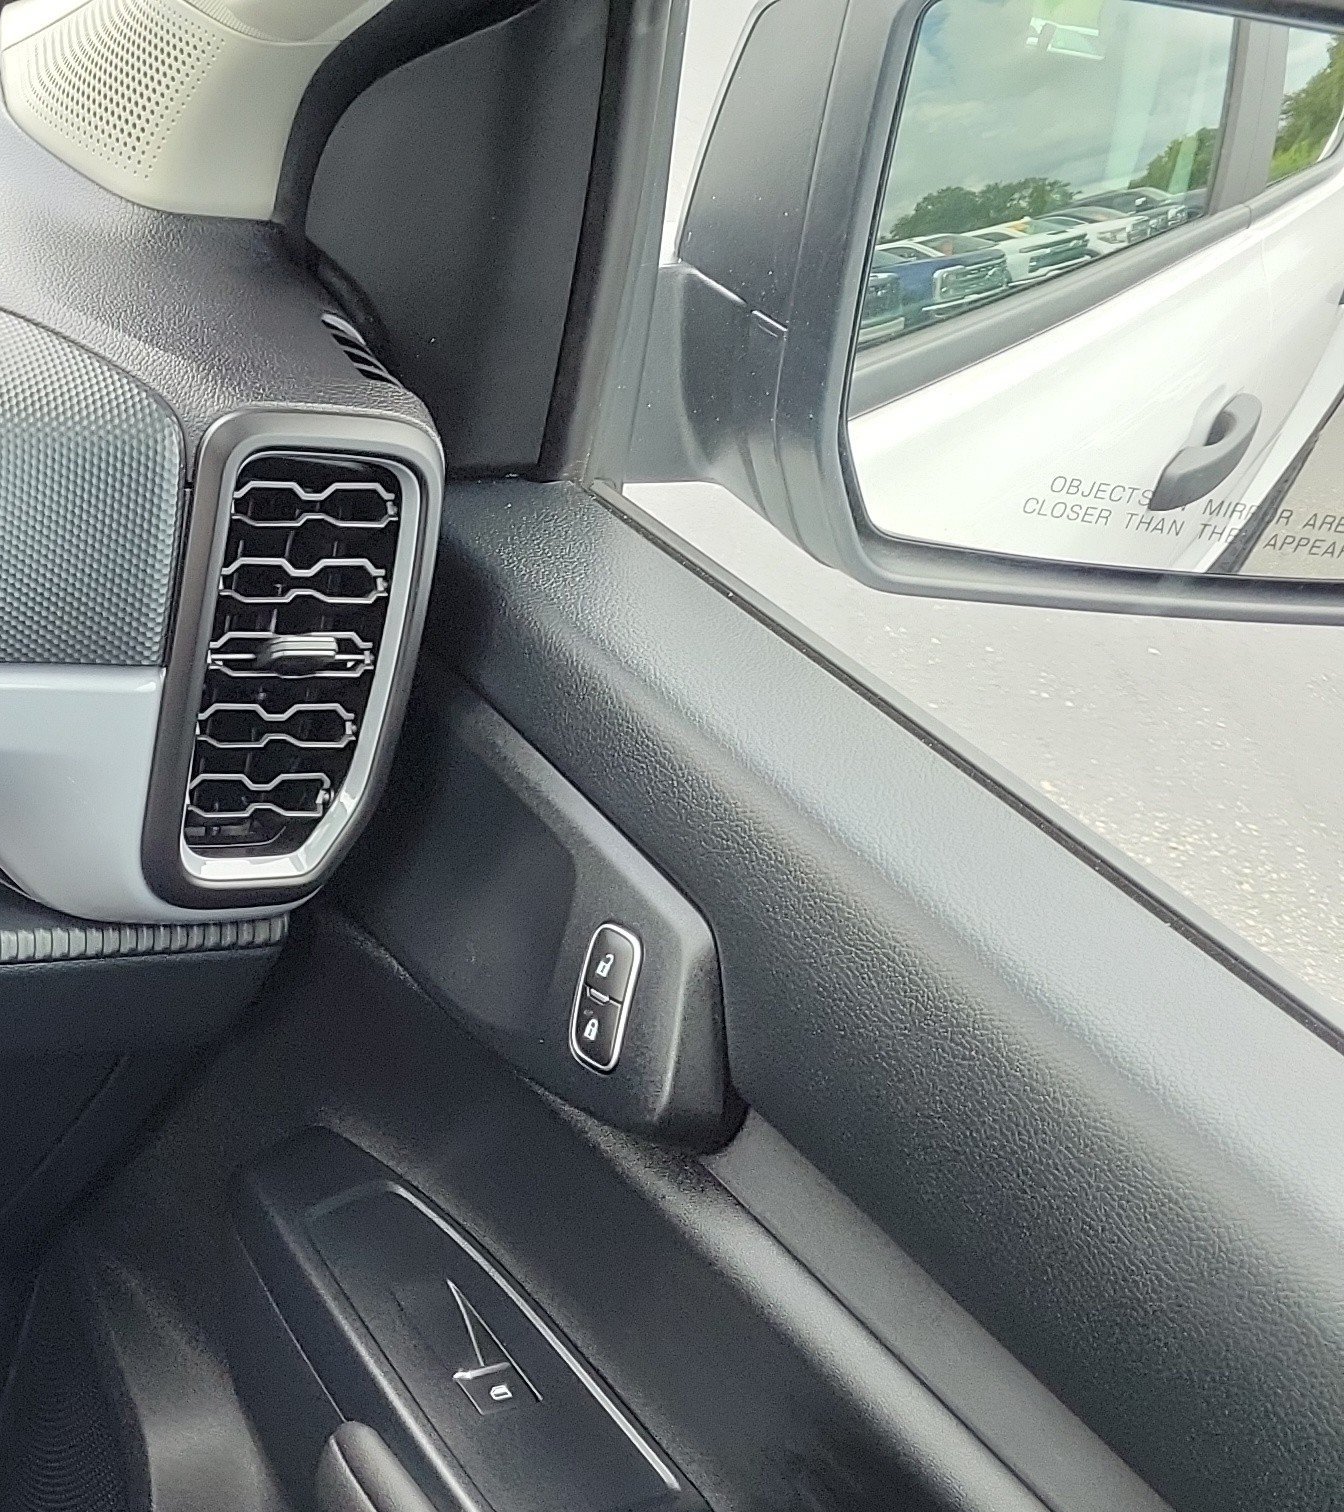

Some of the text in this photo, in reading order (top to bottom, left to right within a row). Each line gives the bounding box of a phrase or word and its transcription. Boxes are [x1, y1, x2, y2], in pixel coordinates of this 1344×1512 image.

[1022, 497, 1112, 526] CLOSER
[1124, 511, 1185, 537] THAN
[1049, 475, 1155, 507] OBJECTS
[1202, 498, 1294, 526] MIRRR
